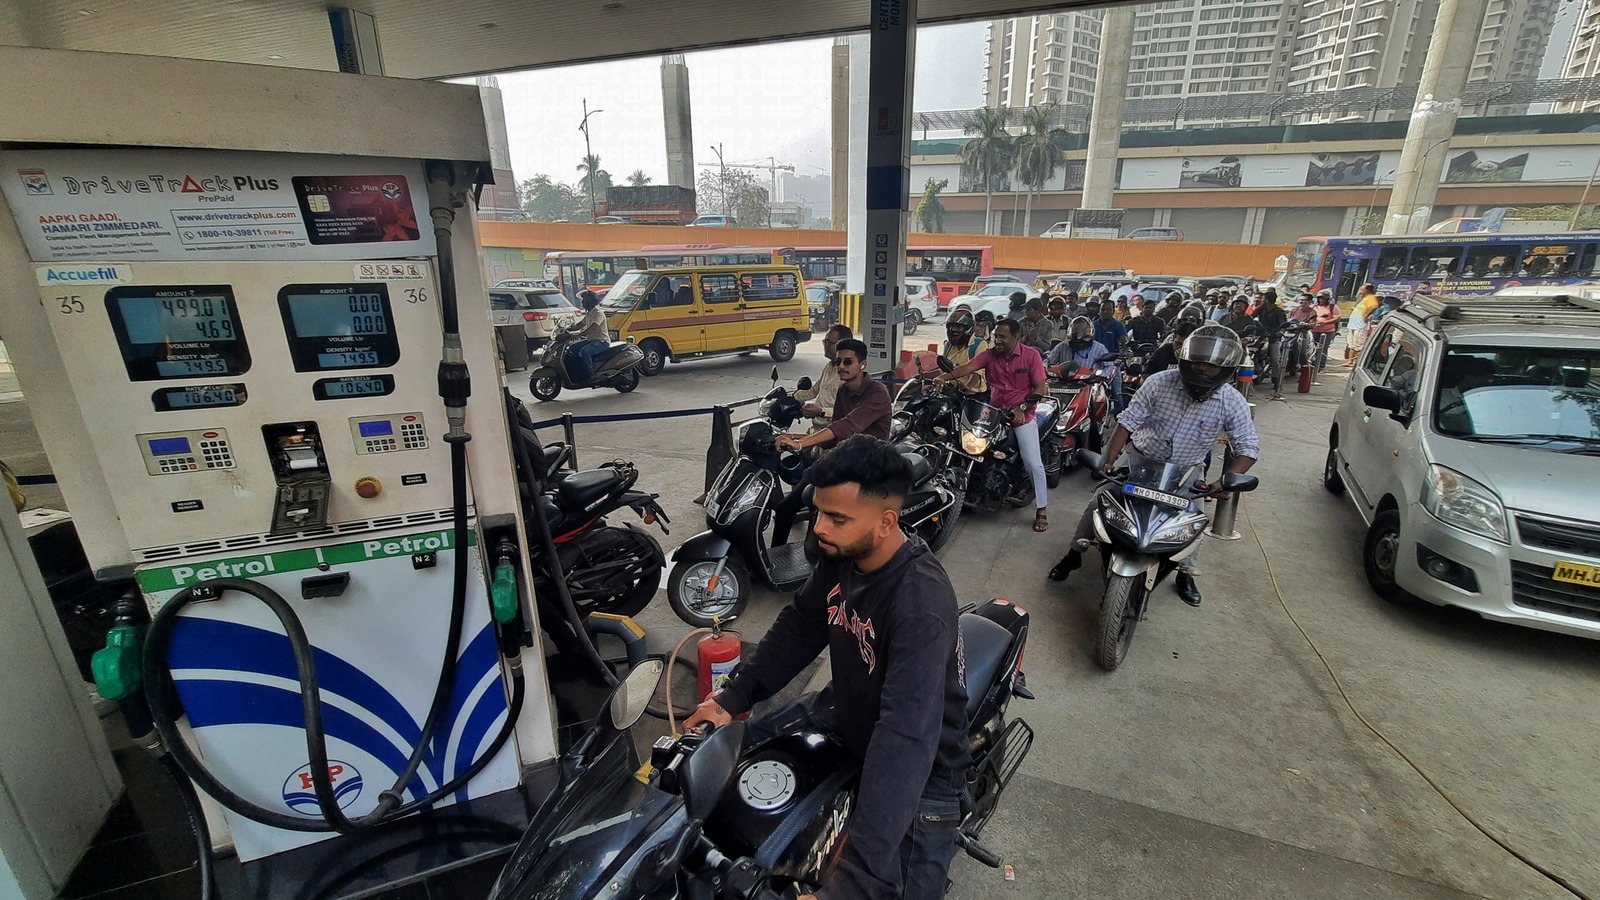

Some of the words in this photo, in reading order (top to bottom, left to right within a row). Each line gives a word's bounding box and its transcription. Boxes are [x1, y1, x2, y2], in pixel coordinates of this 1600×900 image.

[39, 215, 76, 224] AAPKI
[177, 211, 297, 221] www.drivetrackplus.com
[42, 223, 91, 234] HAMARI
[93, 221, 163, 231] ZIMMEDARI.
[196, 229, 262, 238] 1800-10-39811
[97, 232, 139, 240] Management
[47, 267, 119, 281] Accuefill
[404, 287, 428, 304] 36
[56, 295, 85, 314] 35
[163, 299, 228, 318] 499.01
[348, 295, 381, 313] 0.00
[195, 320, 232, 339] 4.69
[353, 315, 384, 333] 0.00
[341, 353, 376, 364] 749.5
[184, 361, 225, 373] 749.5
[340, 381, 382, 393] 106.40
[185, 391, 233, 404] 106.40
[363, 532, 449, 557] Petrol
[171, 555, 275, 585] Petrol
